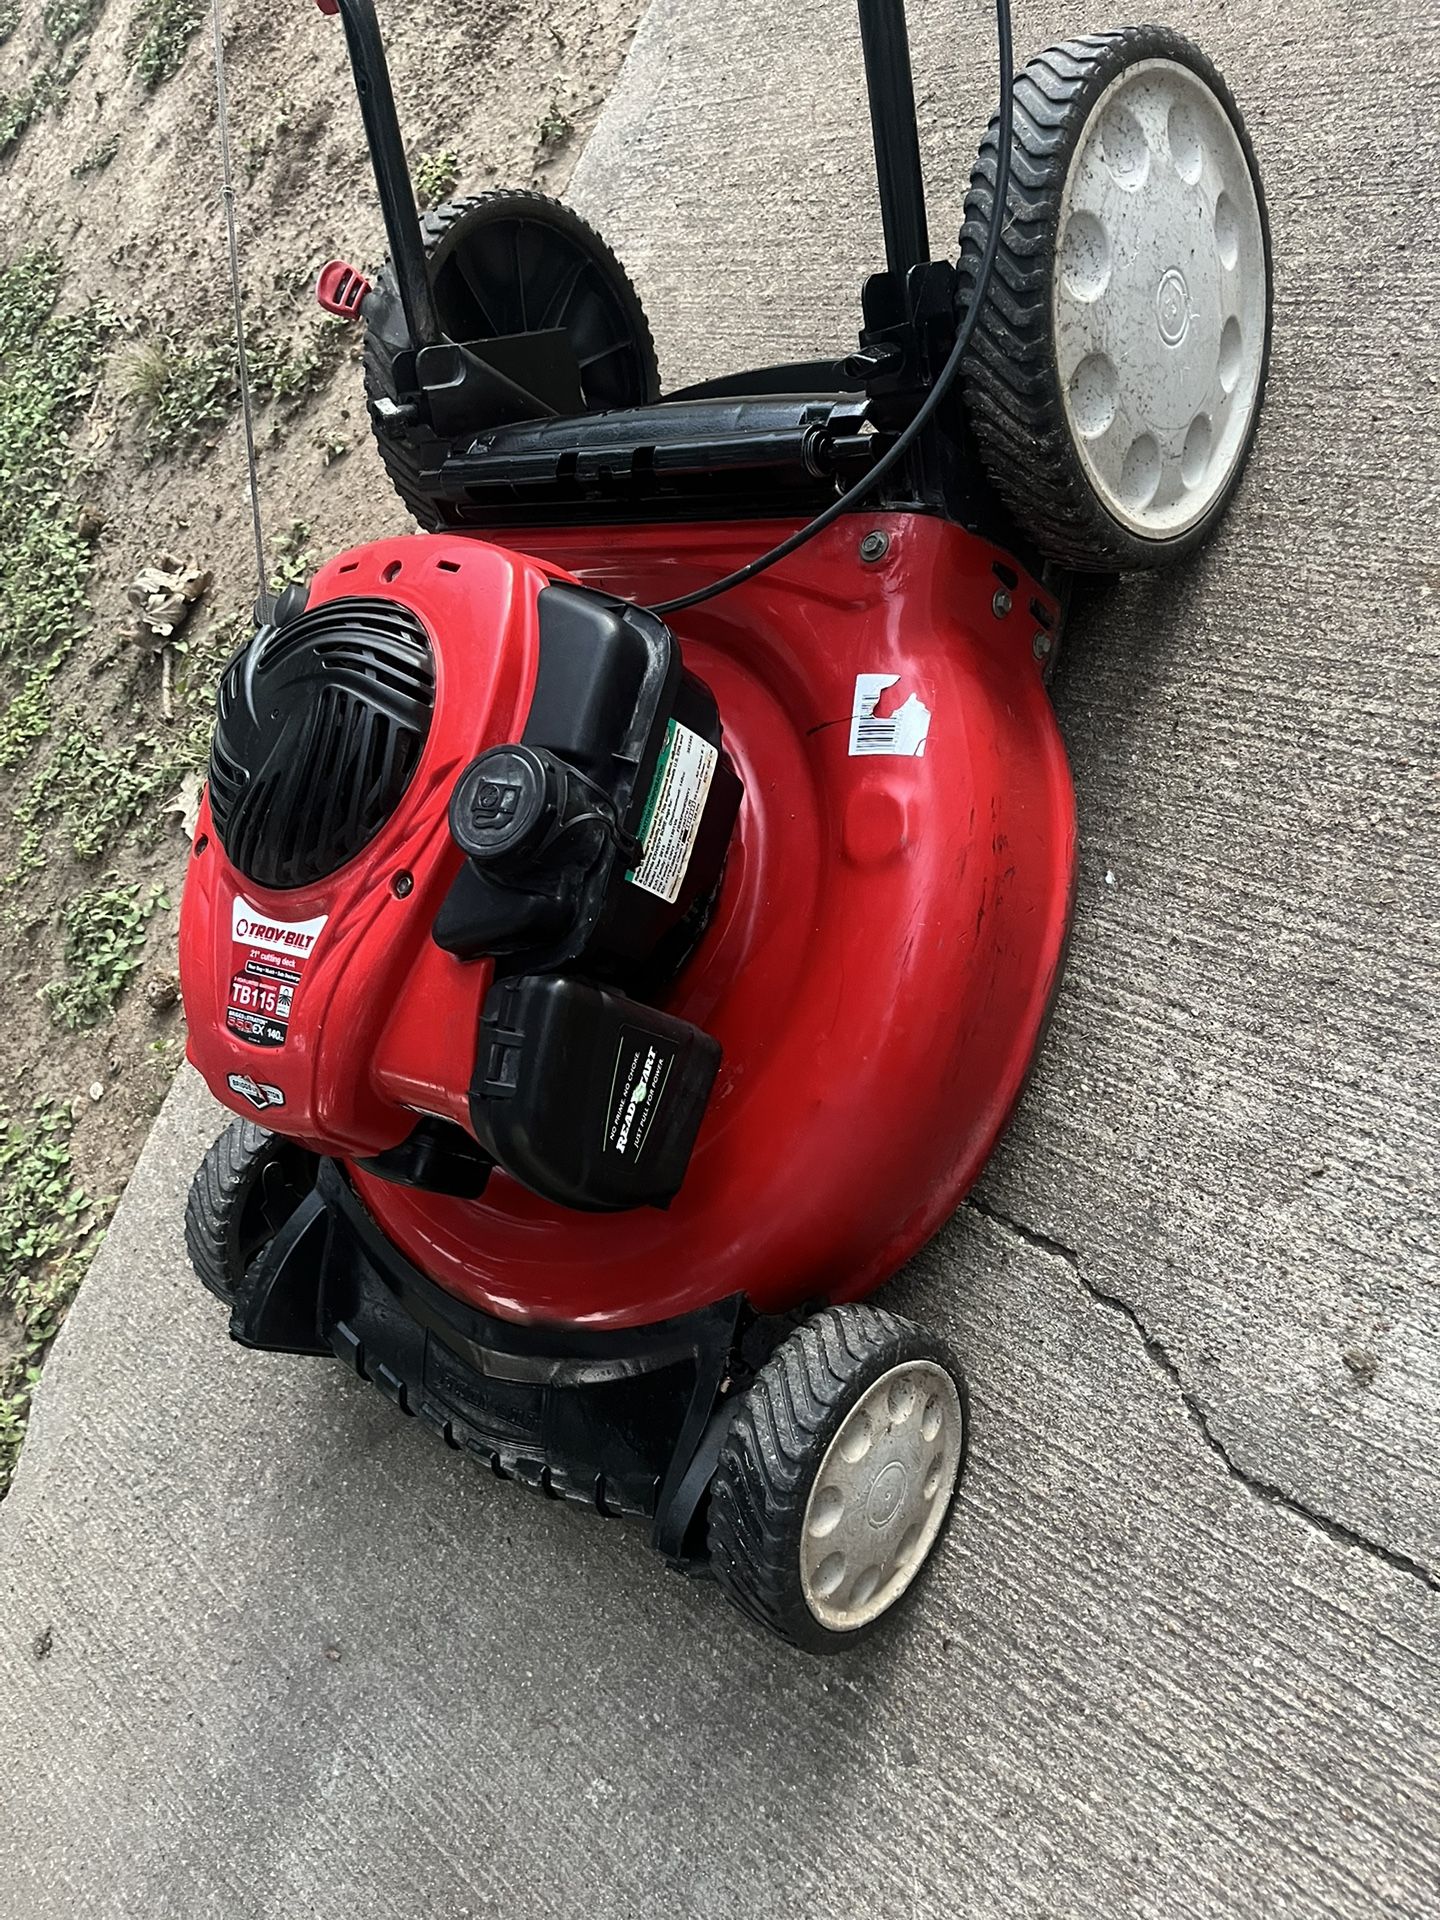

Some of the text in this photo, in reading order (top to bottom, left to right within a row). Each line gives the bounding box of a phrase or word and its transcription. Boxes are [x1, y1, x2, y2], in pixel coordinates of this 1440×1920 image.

[248, 922, 314, 950] TROY-BILT
[260, 953, 281, 965] cutting
[281, 957, 296, 968] deck
[232, 982, 276, 1012] TB115
[609, 1125, 618, 1140] NO
[623, 1082, 631, 1098] NO
[633, 1127, 643, 1149] JUST
[639, 1107, 650, 1128] PULL
[646, 1088, 655, 1106] FOR
